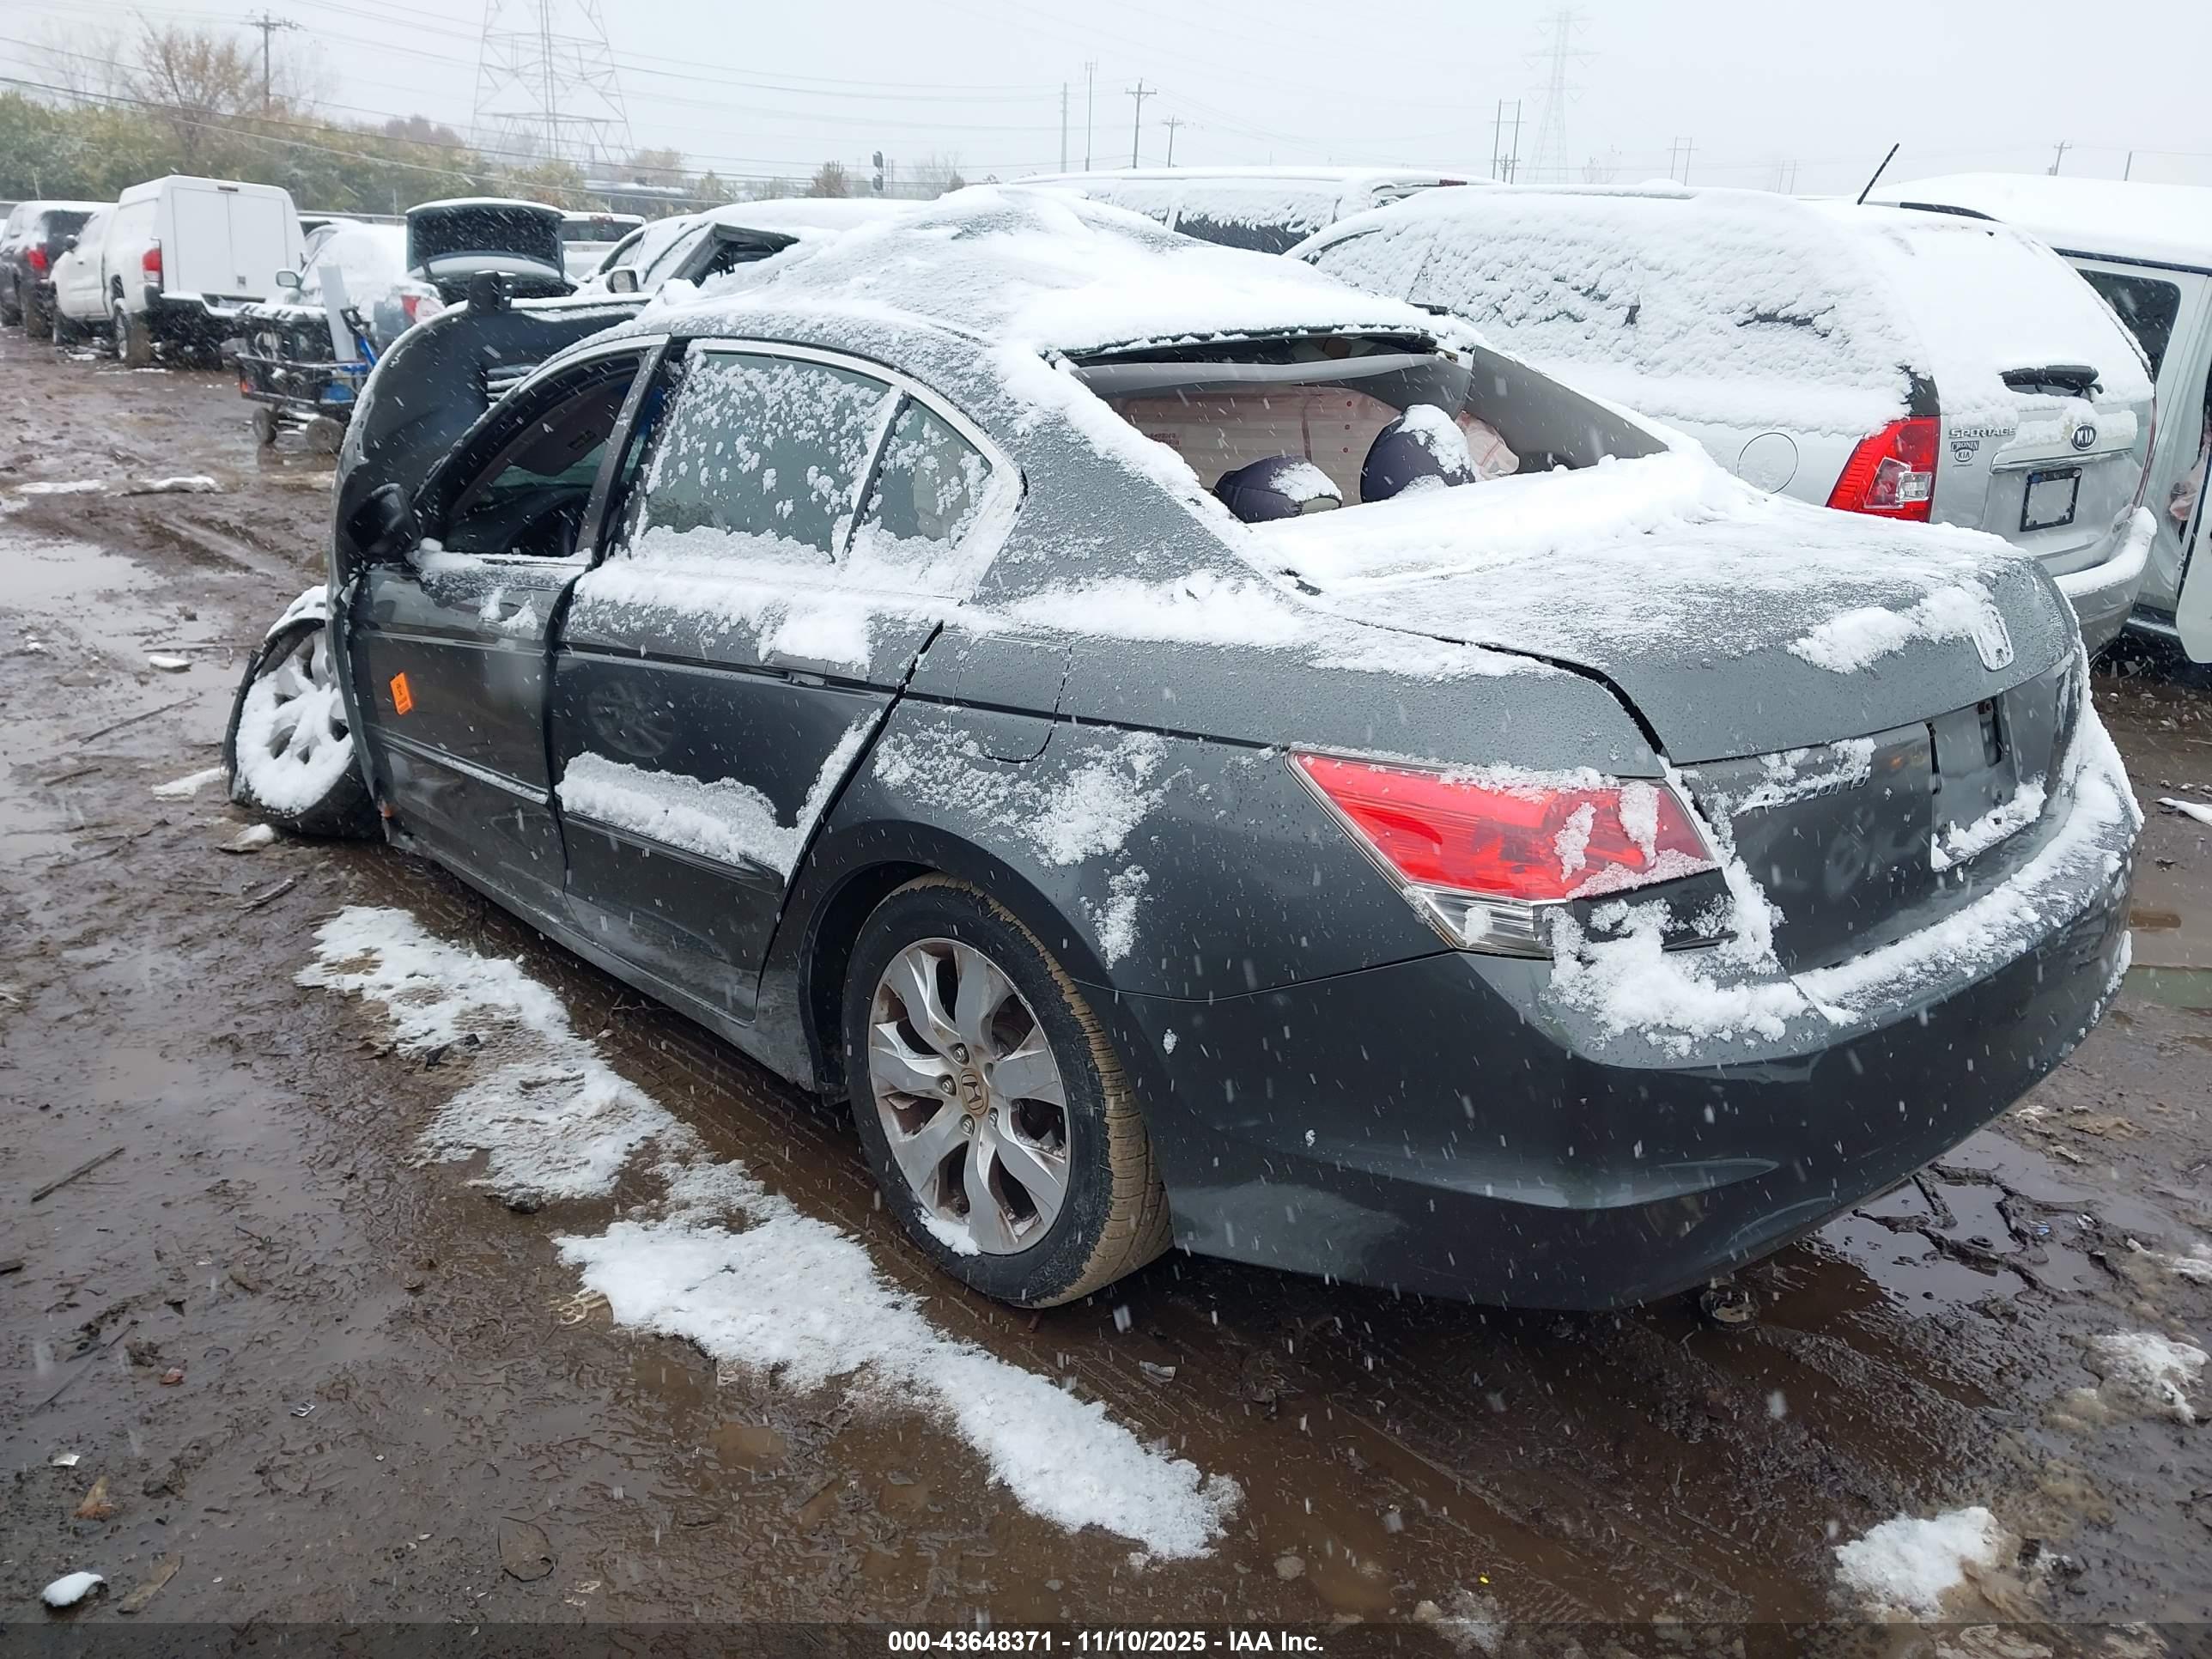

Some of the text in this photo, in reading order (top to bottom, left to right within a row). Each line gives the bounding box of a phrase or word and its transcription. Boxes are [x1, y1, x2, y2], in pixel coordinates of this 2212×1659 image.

[1948, 427, 2016, 438] SPORTAGE
[2076, 429, 2094, 444] KIA
[1951, 441, 1978, 451] CRONIN
